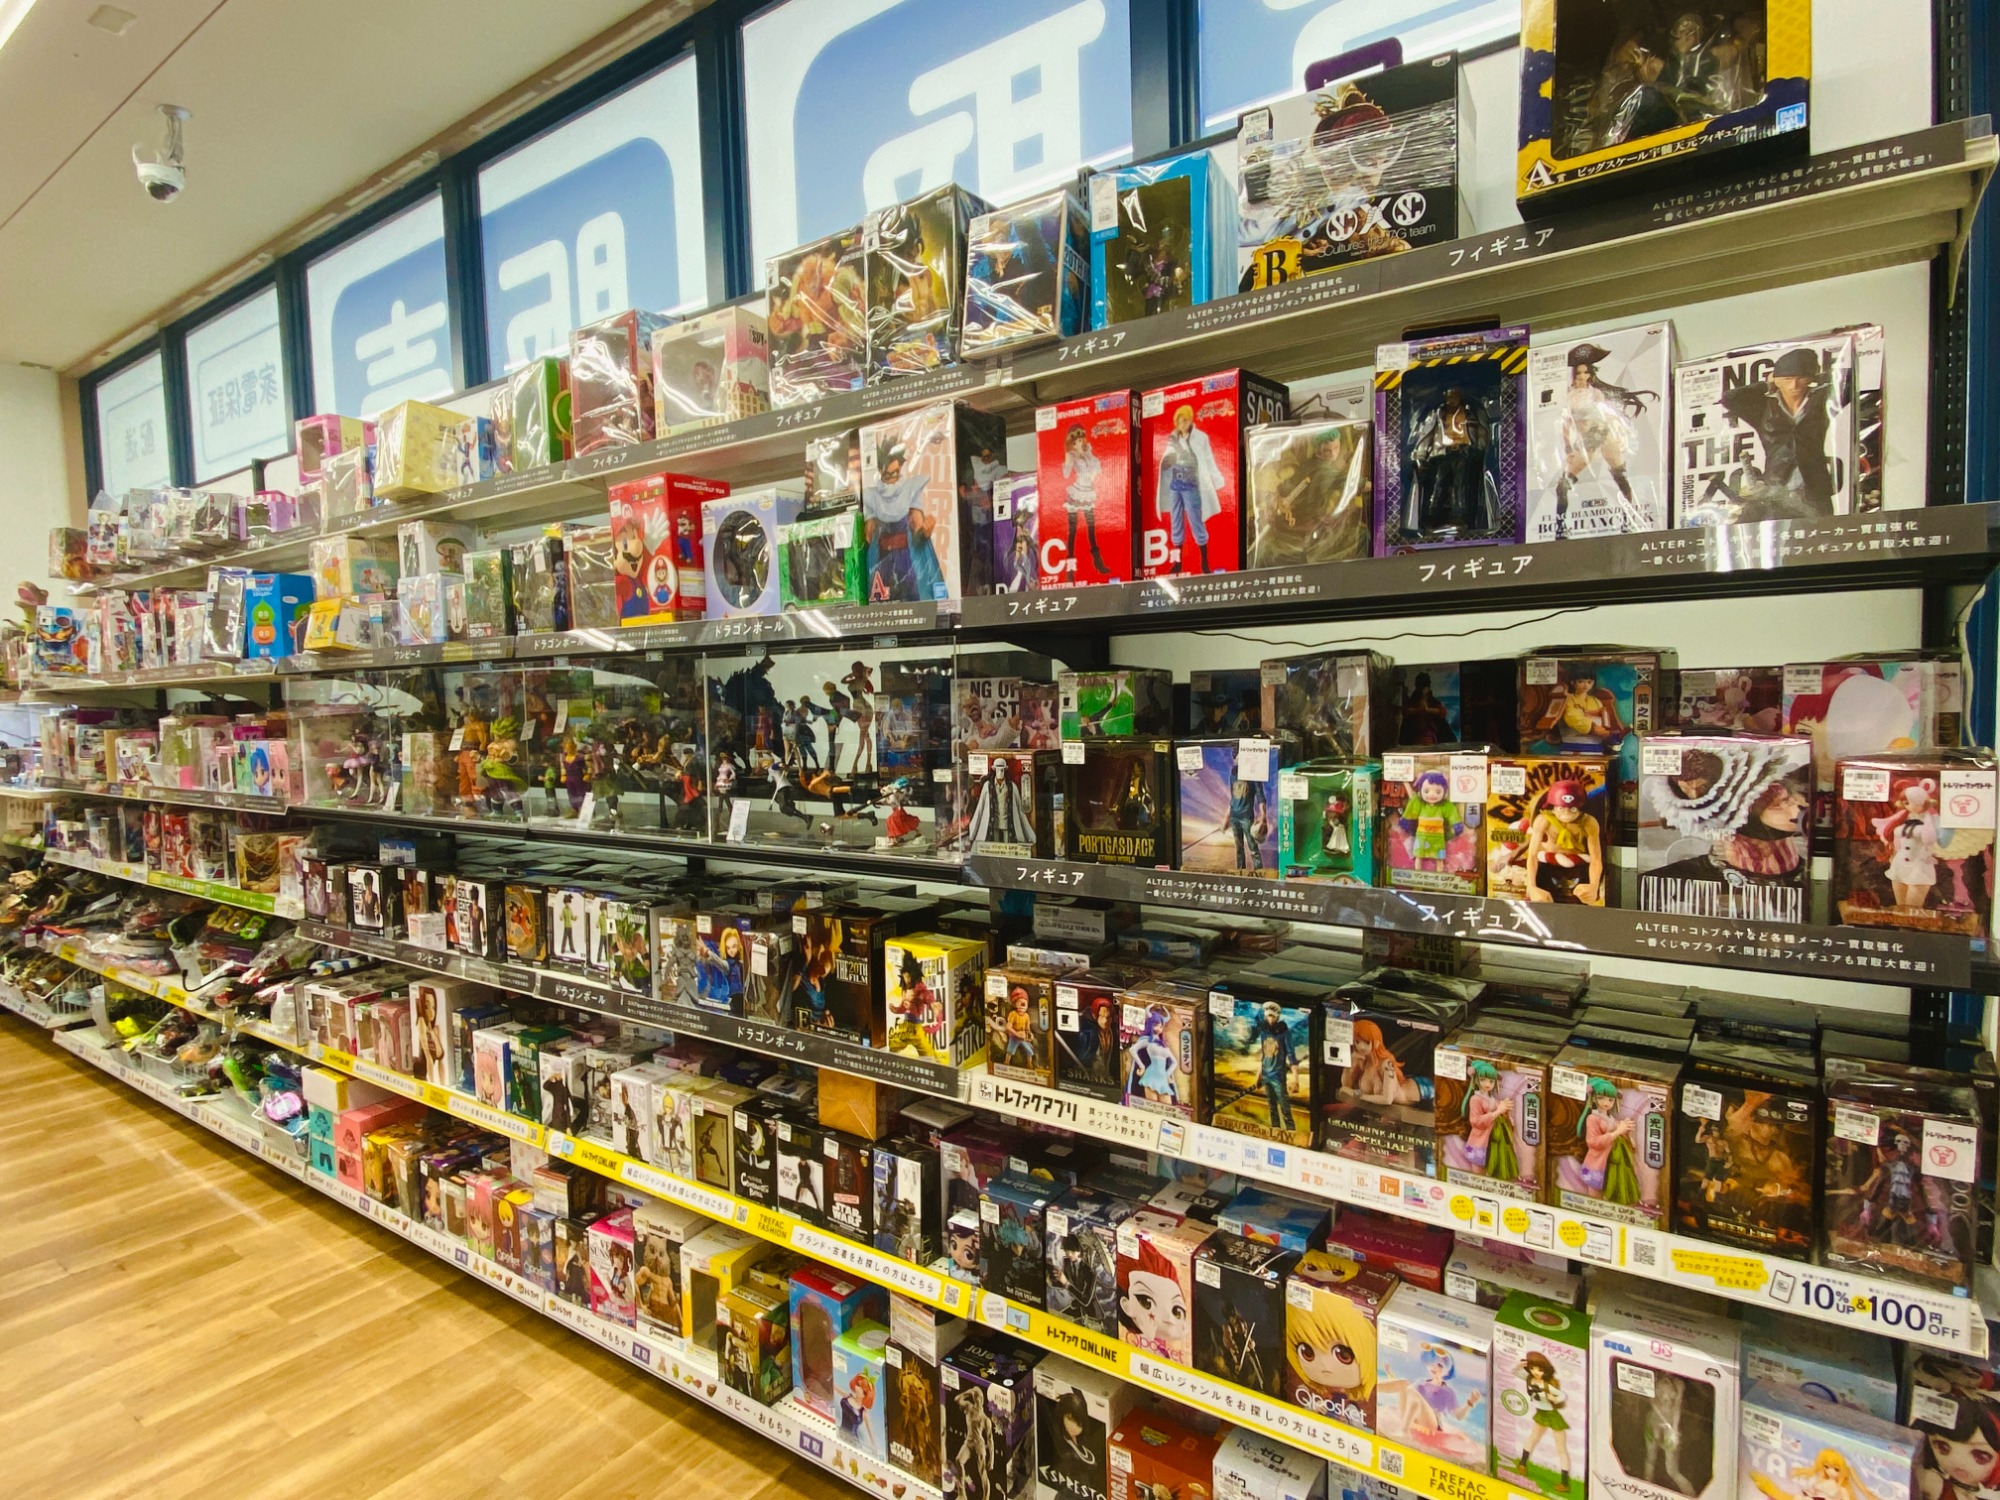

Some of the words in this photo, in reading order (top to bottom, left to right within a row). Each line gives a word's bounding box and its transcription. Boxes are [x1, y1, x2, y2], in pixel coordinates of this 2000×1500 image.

[1409, 224, 1436, 237] team
[1448, 227, 1555, 267] フィギュア
[1058, 332, 1127, 361] フィギュア
[777, 406, 822, 427] フィギュア
[592, 453, 628, 469] フィギュア
[1684, 432, 1754, 469] THE
[1419, 554, 1533, 583] フィギュア
[1008, 597, 1078, 615] フィギュア
[714, 621, 784, 637] ドラゴンボール
[394, 649, 421, 660] ワンピース
[1016, 867, 1085, 887] フィギュア
[416, 952, 444, 966] ワンピース
[555, 985, 606, 1005] ドラゴンボール
[736, 1027, 805, 1051] ドラゴンボール
[996, 1085, 1078, 1122] トレファクアプリ
[1089, 1107, 1153, 1130] 買っても売っても
[1526, 1098, 1537, 1140] 光月日和
[1649, 1118, 1661, 1161] 光月日和
[832, 1203, 859, 1215] STAR
[760, 1214, 784, 1229] TREFAC
[832, 1213, 862, 1227] WARS
[758, 1223, 787, 1239] FASHION
[1837, 1304, 1856, 1315] UP
[1856, 1298, 1867, 1311] &
[1929, 1324, 1960, 1339] OFF
[1047, 1326, 1079, 1347] トレファク
[1080, 1339, 1117, 1363] ONLINE
[1603, 1340, 1632, 1355] SEGA
[1140, 1363, 1361, 1455] 幅広いジャンルをお探しの方はこちら
[1430, 1467, 1486, 1495] TREFAC
